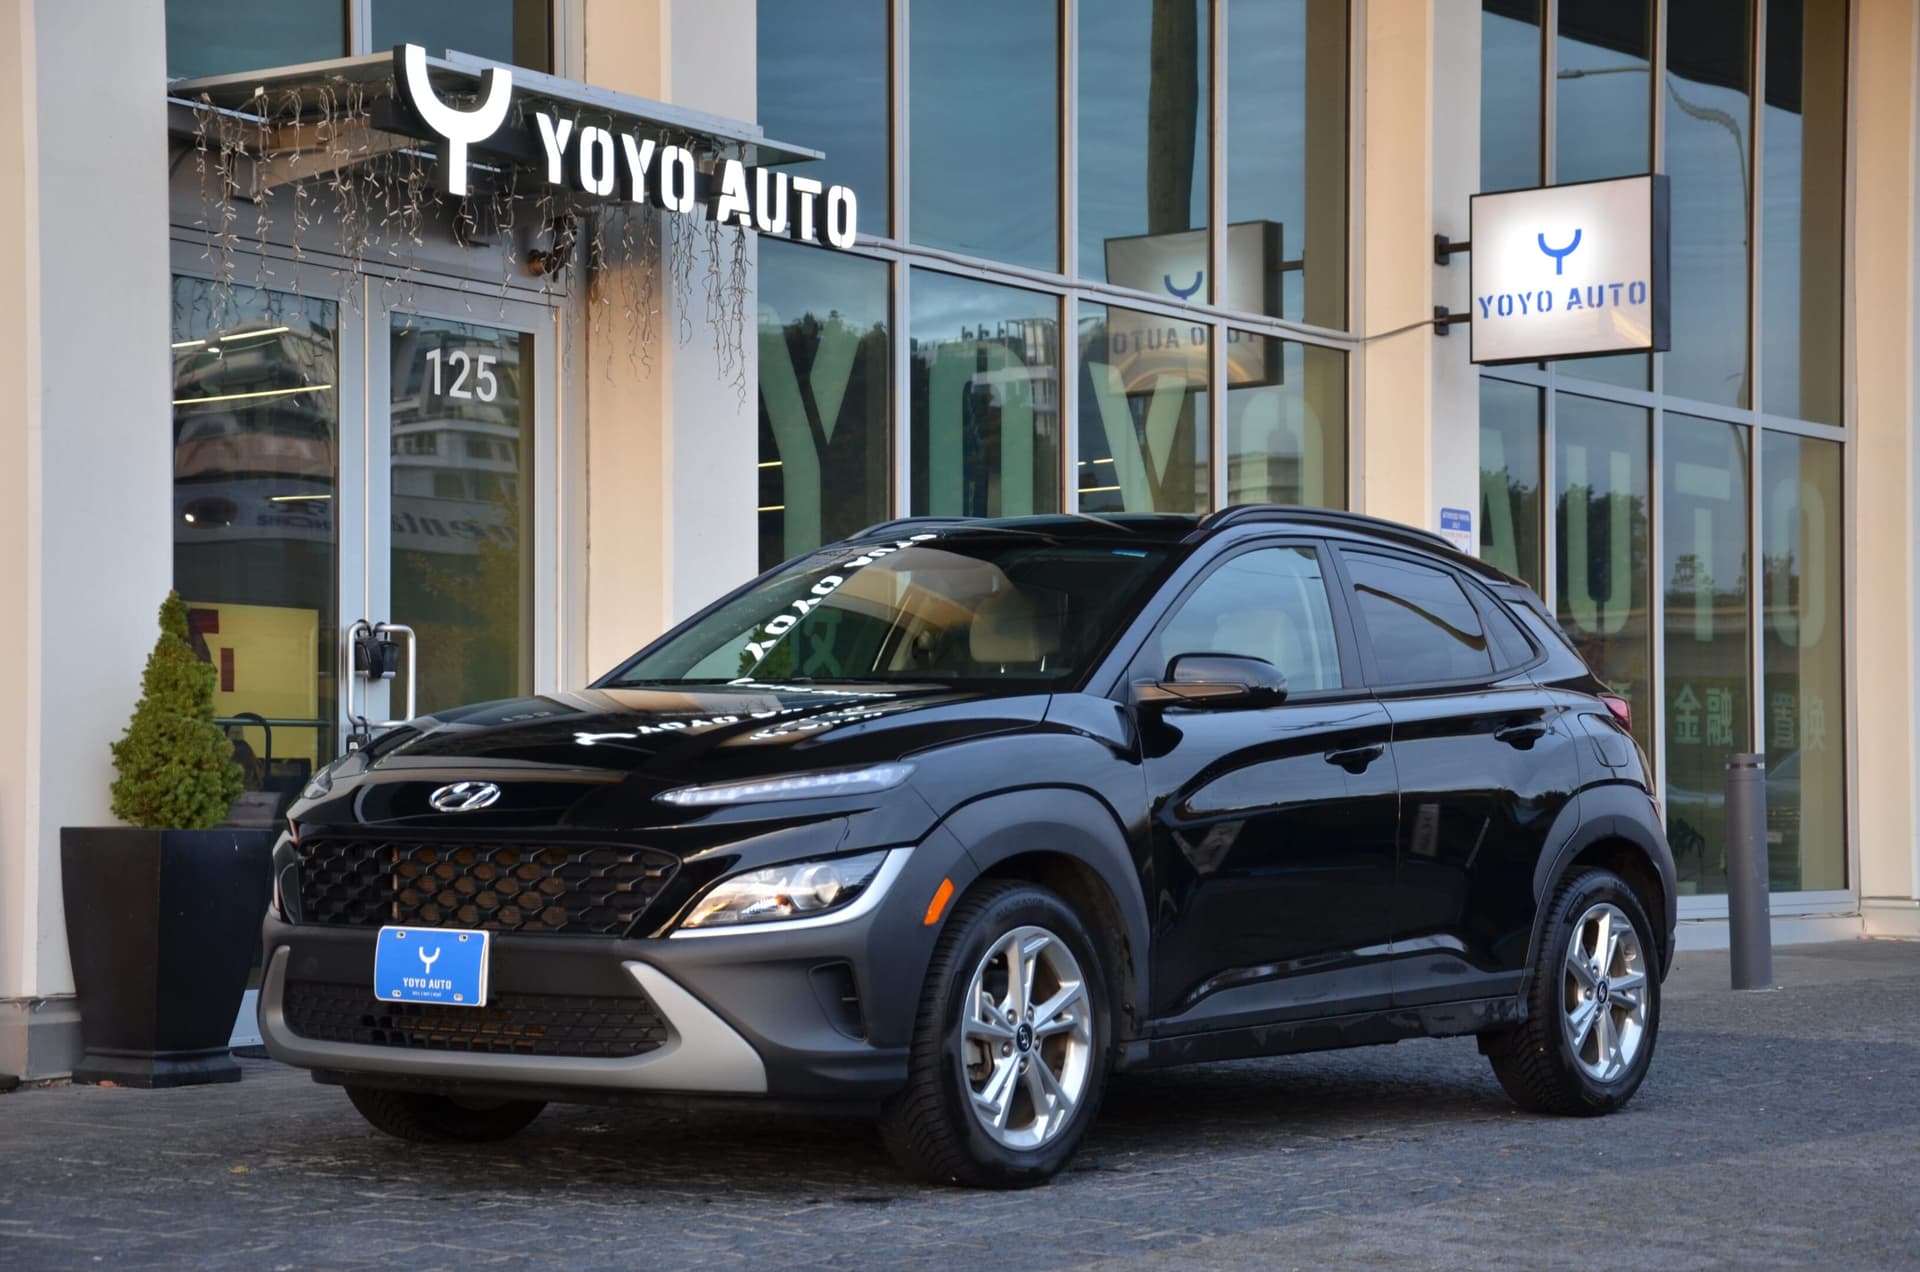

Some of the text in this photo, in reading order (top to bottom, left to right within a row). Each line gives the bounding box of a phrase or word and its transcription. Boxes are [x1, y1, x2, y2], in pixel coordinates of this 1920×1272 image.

[535, 112, 858, 250] YOYO AUTO
[1478, 280, 1647, 319] YOYO AUTO
[426, 349, 499, 402] 125
[1673, 682, 1734, 747] 金融
[402, 977, 452, 990] YOYO AUTO
